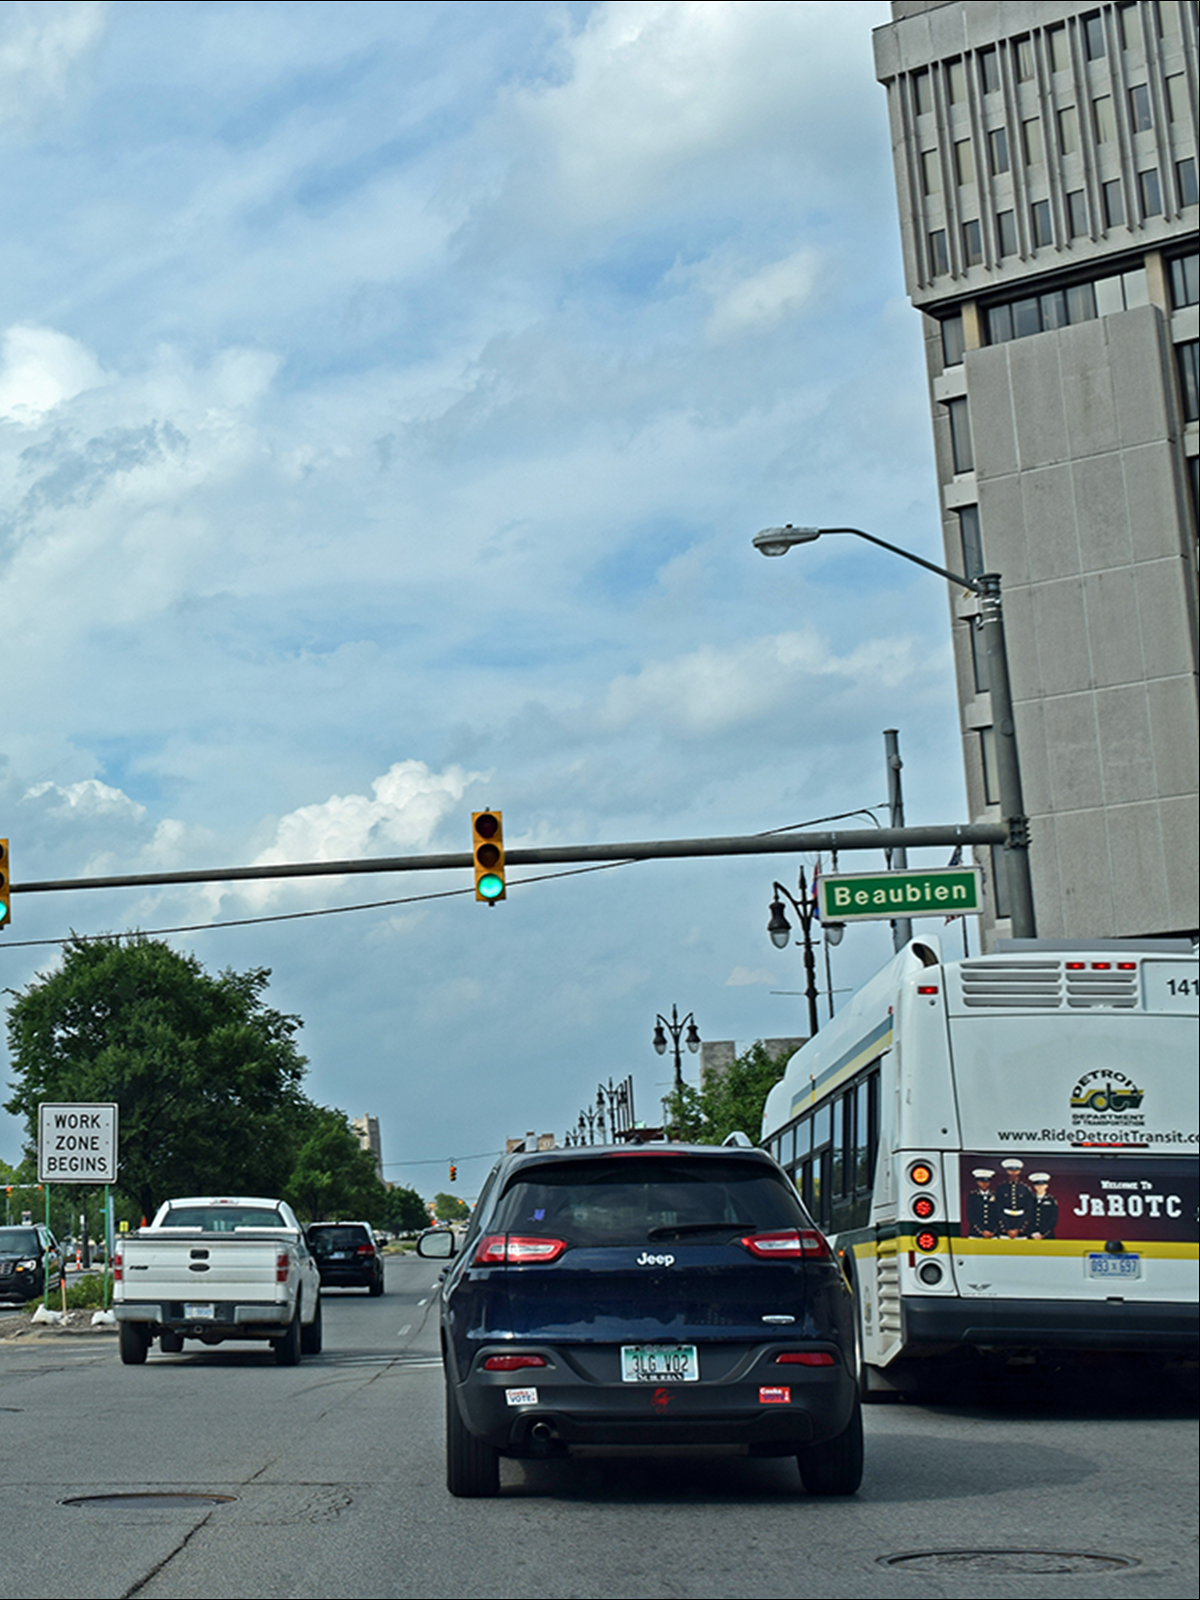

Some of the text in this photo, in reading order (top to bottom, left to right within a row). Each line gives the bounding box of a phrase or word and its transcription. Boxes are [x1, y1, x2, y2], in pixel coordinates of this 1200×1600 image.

[834, 882, 967, 907] Beaubien
[1072, 1069, 1139, 1098] DETROIT
[54, 1113, 101, 1129] WORK
[55, 1135, 100, 1151] ZONE
[47, 1156, 107, 1172] BEGINS
[637, 1252, 675, 1267] Jeep
[632, 1354, 656, 1373] 3LG
